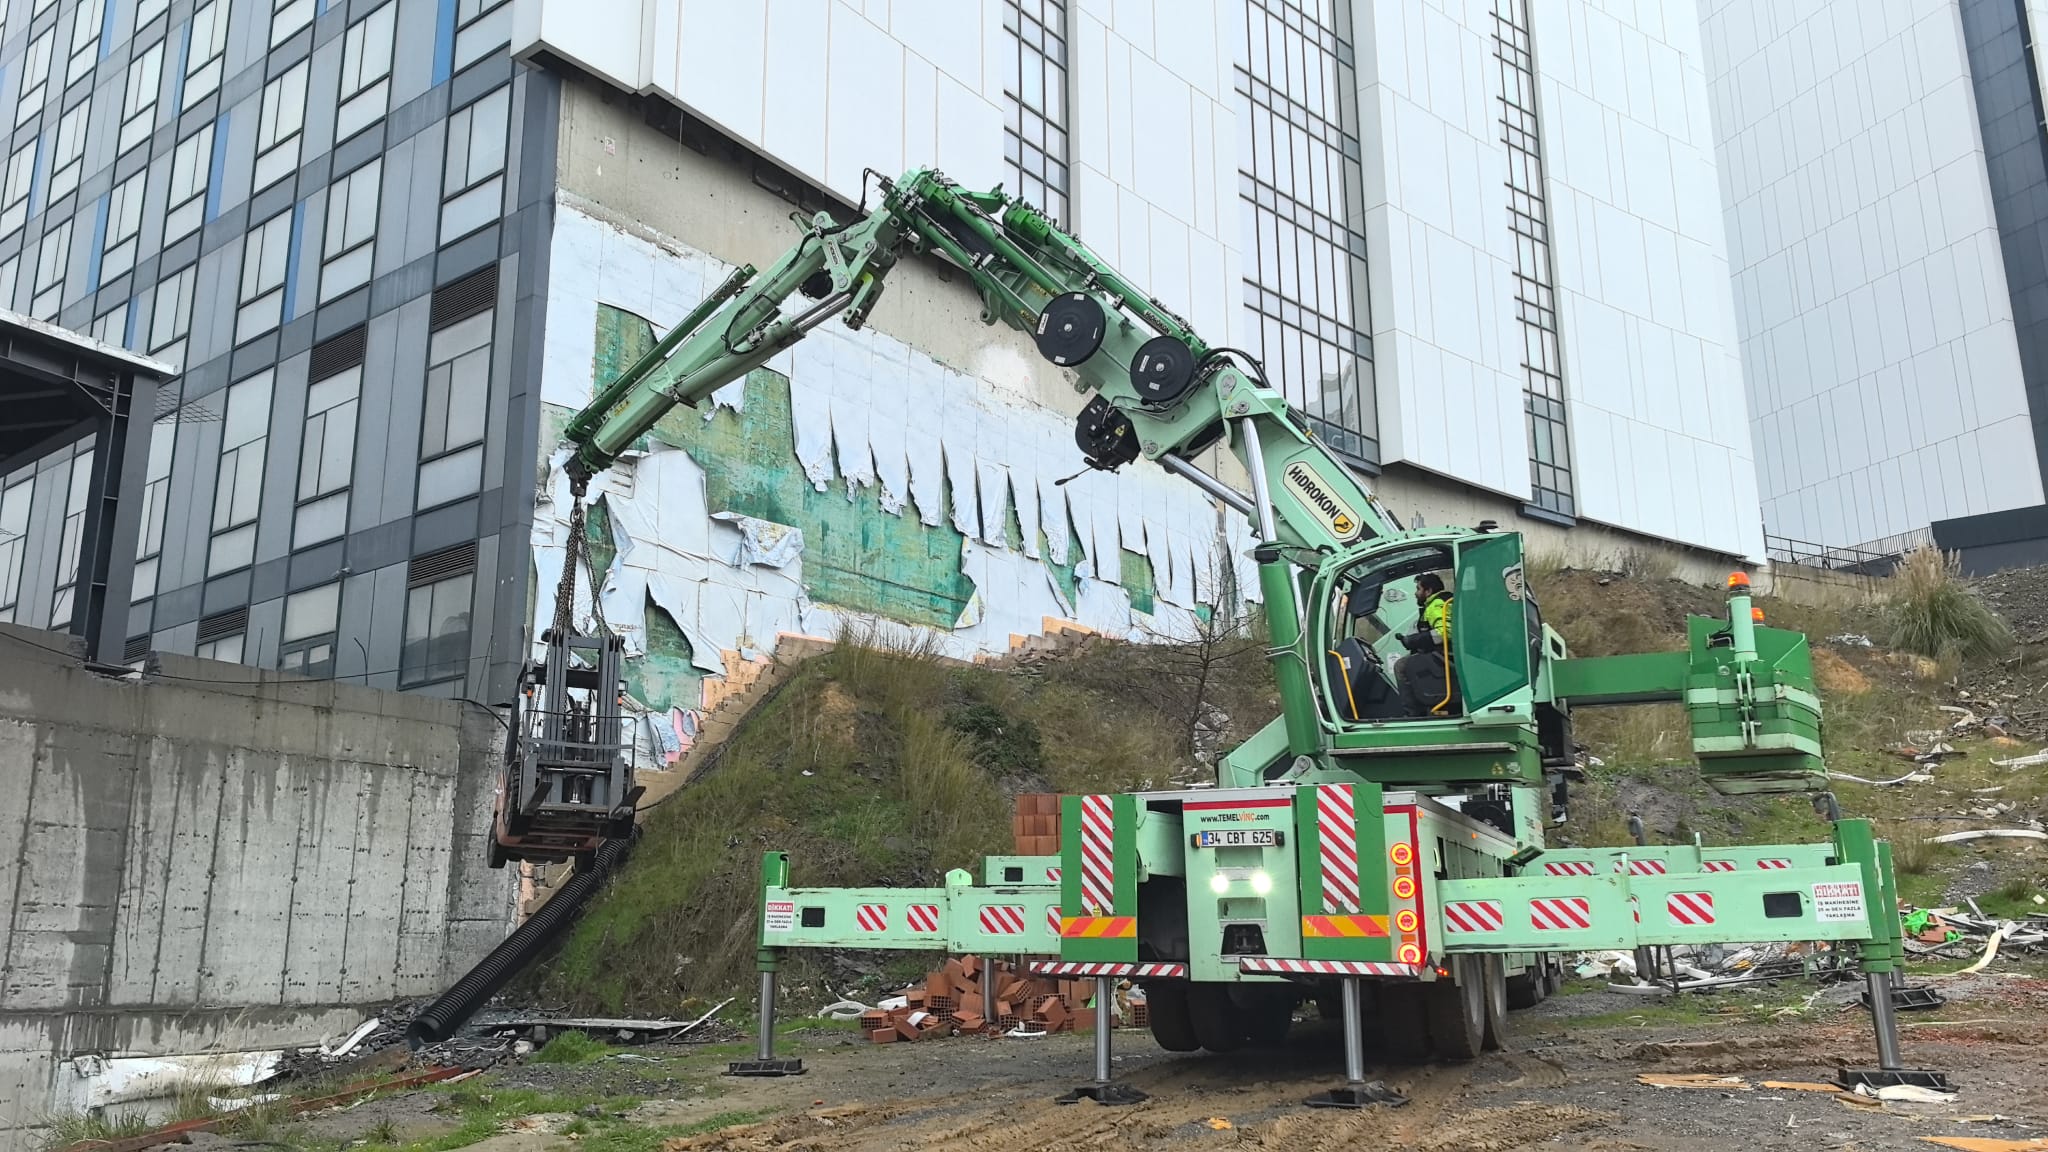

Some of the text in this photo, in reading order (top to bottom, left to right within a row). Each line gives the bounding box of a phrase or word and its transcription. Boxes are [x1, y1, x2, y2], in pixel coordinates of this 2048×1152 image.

[1200, 811, 1270, 823] www.TEMELVİNÇ.com
[1208, 831, 1272, 845] 34 CBT 625
